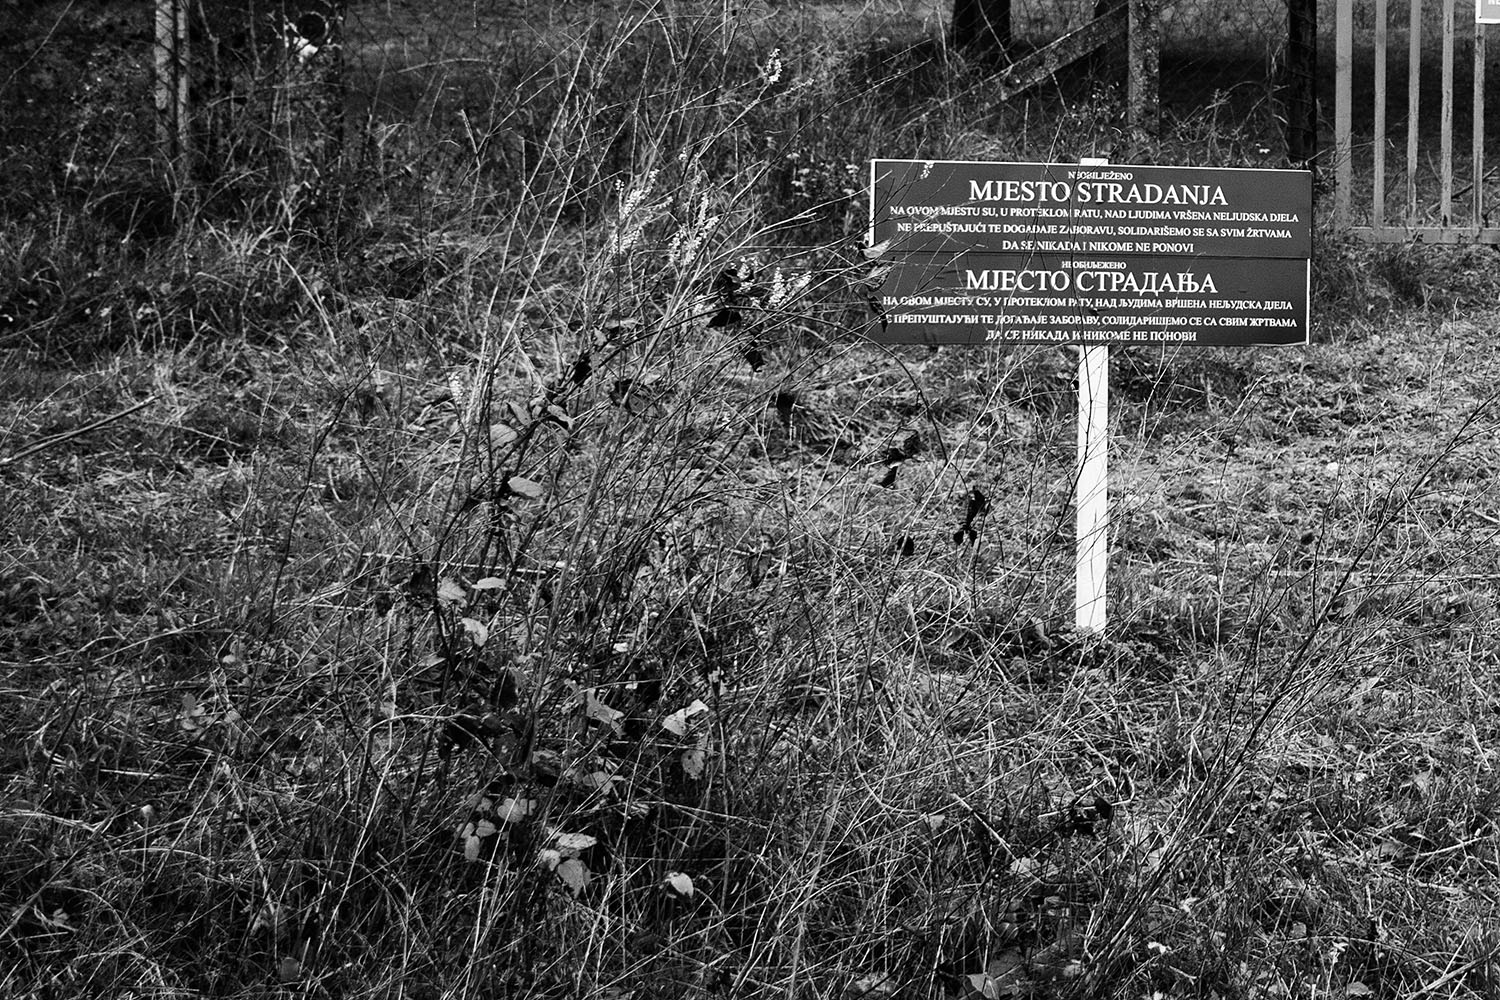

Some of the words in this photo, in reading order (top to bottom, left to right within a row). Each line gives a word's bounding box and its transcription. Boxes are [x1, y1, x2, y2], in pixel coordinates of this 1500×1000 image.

[969, 180, 1071, 202] MJESTO
[1077, 182, 1228, 206] STRADANJA
[890, 206, 905, 215] NA
[906, 206, 939, 215] OVOM
[940, 206, 981, 217] MJESTU
[983, 208, 999, 218] SU,
[1000, 208, 1008, 216] U
[1010, 208, 1071, 217] PROTEKLOM
[1074, 209, 1103, 219] RATU,
[1104, 210, 1127, 218] NAD
[1128, 210, 1172, 219] LJUDIMA
[1173, 210, 1211, 220] VRŠENA
[1213, 212, 1268, 221] NELJUDSKA
[1270, 213, 1299, 222] DJELA
[897, 223, 912, 232] NE
[988, 224, 1001, 233] TE
[1118, 226, 1191, 236] SOLIDARIŠEMO
[1193, 227, 1205, 236] SE
[1206, 228, 1219, 237] SA
[1220, 228, 1245, 237] SVIM
[1246, 227, 1292, 238] ŽRTVAMA
[1002, 240, 1019, 250] DA
[1021, 241, 1034, 250] SE
[1037, 241, 1081, 251] NIKADA
[1082, 242, 1087, 250] I
[1089, 242, 1134, 252] NIKOME
[1135, 243, 1150, 252] NE
[1152, 243, 1194, 253] PONOVI
[966, 269, 1070, 292] МЈЕСТО
[1076, 271, 1218, 297] СТРАДАЊА
[883, 296, 899, 305] НА
[900, 296, 932, 306] ОВОМ
[934, 296, 974, 306] МЈЕСТУ
[976, 297, 992, 307] СУ,
[994, 297, 1001, 306] У
[1003, 297, 1066, 307] ПРОТЕКЛОМ
[1095, 298, 1117, 308] НАД
[1118, 299, 1163, 308] ЉУДИМА
[1165, 299, 1207, 309] ВРШЕНА
[1209, 300, 1262, 310] НЕЉУДСКА
[1263, 301, 1293, 310] ДЈЕЛА
[894, 314, 979, 324] ПРЕПУШТАЈУЋИ
[980, 315, 994, 324] ТЕ
[1102, 316, 1187, 326] СОЛИДАРИШЕМО
[1189, 317, 1202, 326] СЕ
[1203, 317, 1217, 326] СА
[1219, 317, 1248, 326] СВИМ
[1249, 318, 1297, 327] ЖРТВАМА
[986, 330, 1002, 341] ДА
[1022, 330, 1070, 341] НИКАДА
[1072, 331, 1081, 340] И
[1083, 331, 1131, 341] НИКОМЕ
[1133, 331, 1148, 340] НЕ
[1150, 331, 1197, 341] ПОНОВИ
